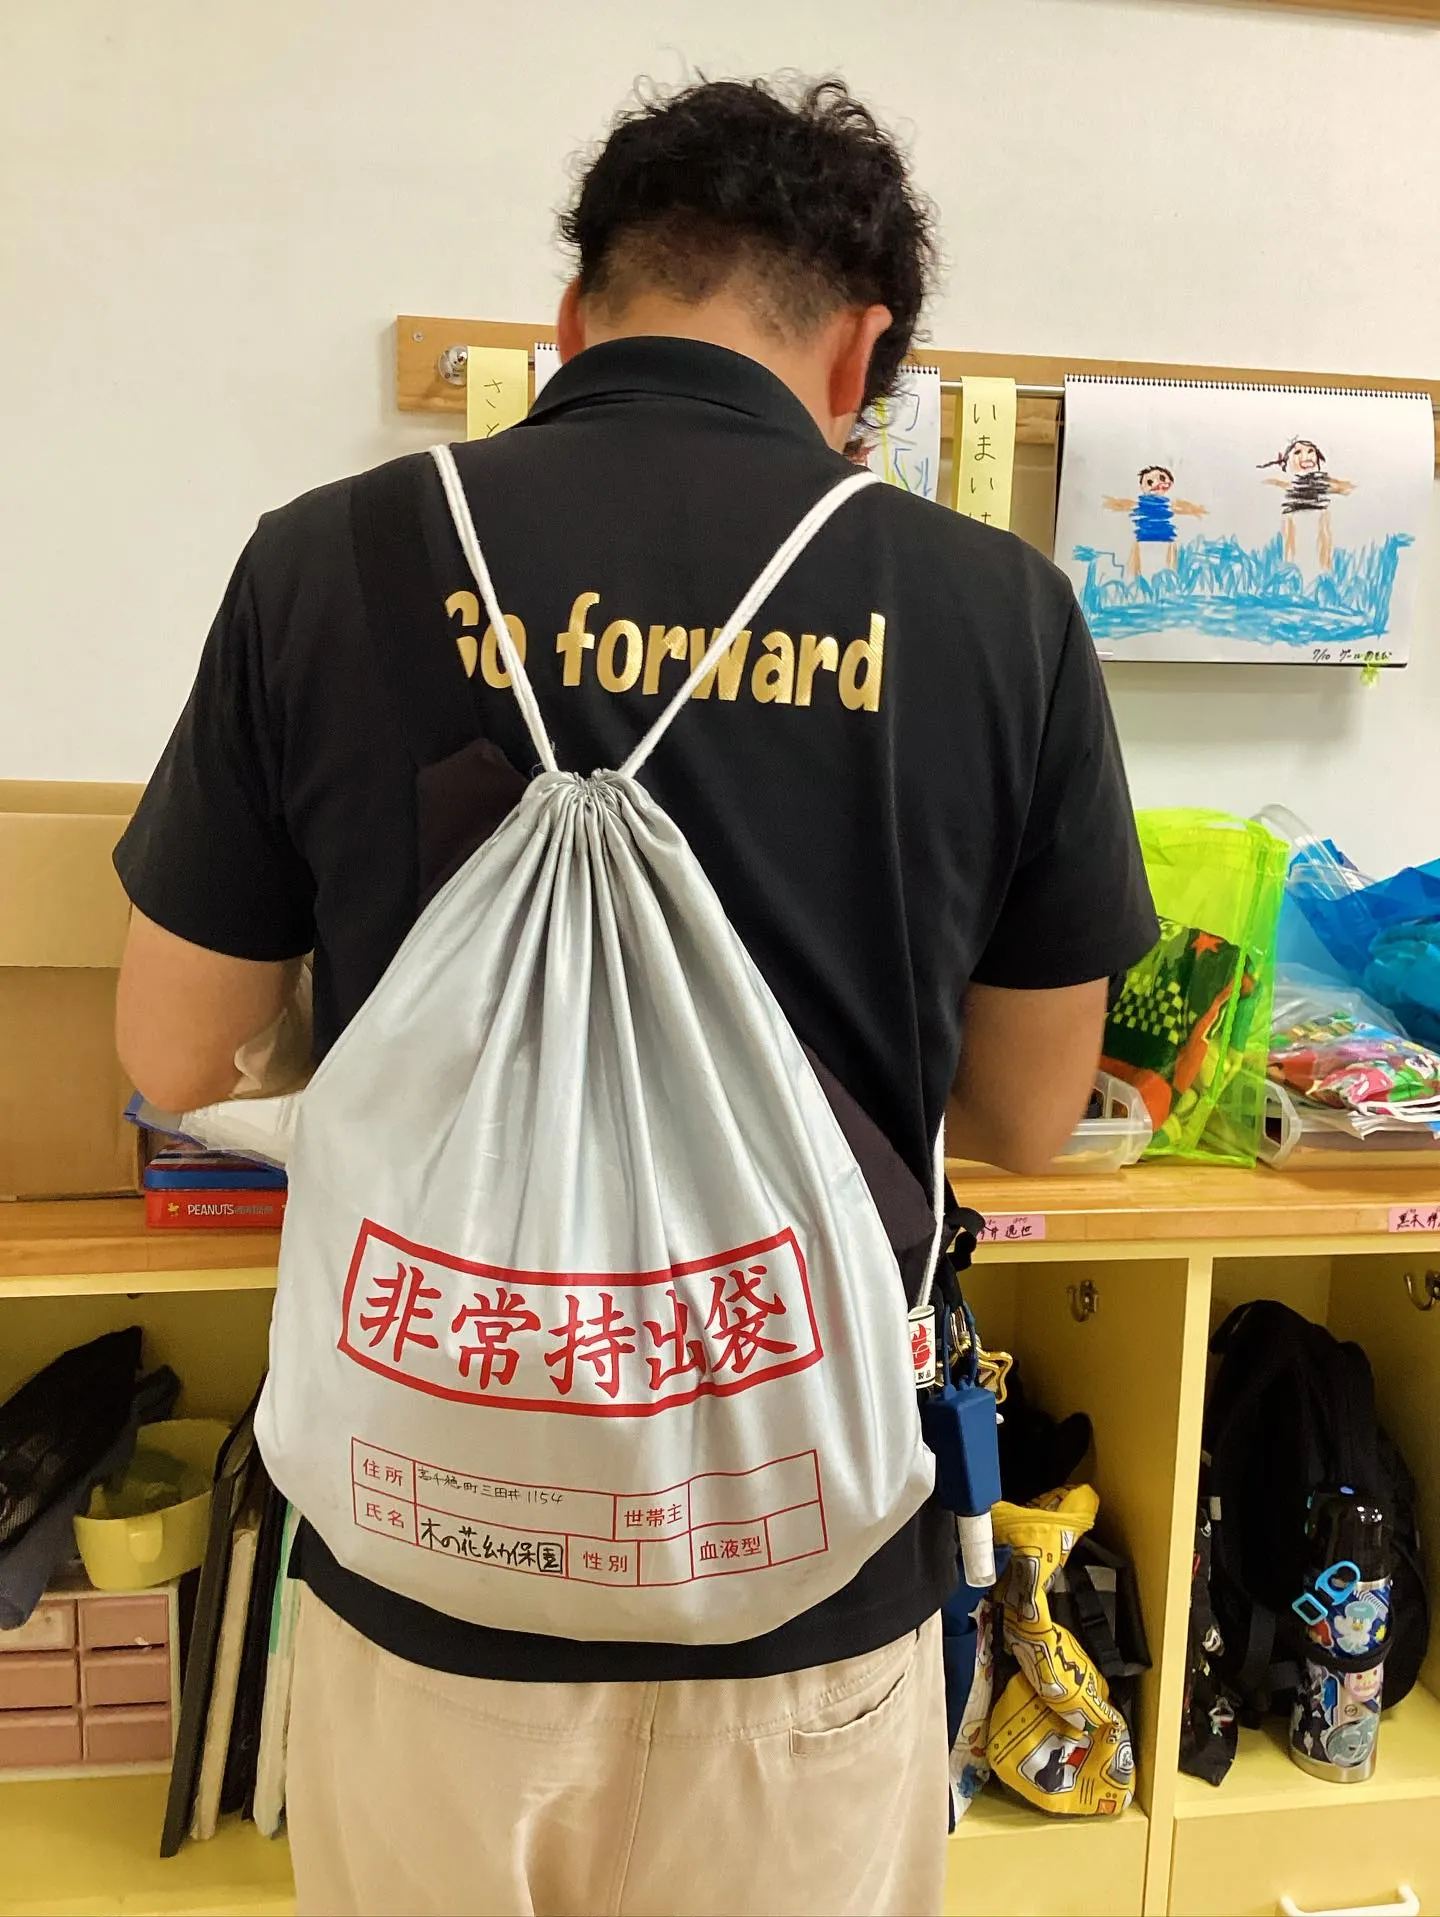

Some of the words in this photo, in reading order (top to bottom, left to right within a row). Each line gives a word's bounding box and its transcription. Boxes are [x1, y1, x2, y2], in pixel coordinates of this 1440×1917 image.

[556, 591, 887, 712] forward
[187, 1203, 235, 1216] PEANUTS
[360, 1262, 797, 1398] 非常持出袋
[363, 1458, 403, 1487] 住所
[527, 1490, 563, 1505] 1154
[366, 1502, 405, 1529] 氏名
[624, 1503, 683, 1528] 世帯主
[583, 1551, 628, 1573] 性別
[699, 1535, 762, 1562] 血液型
